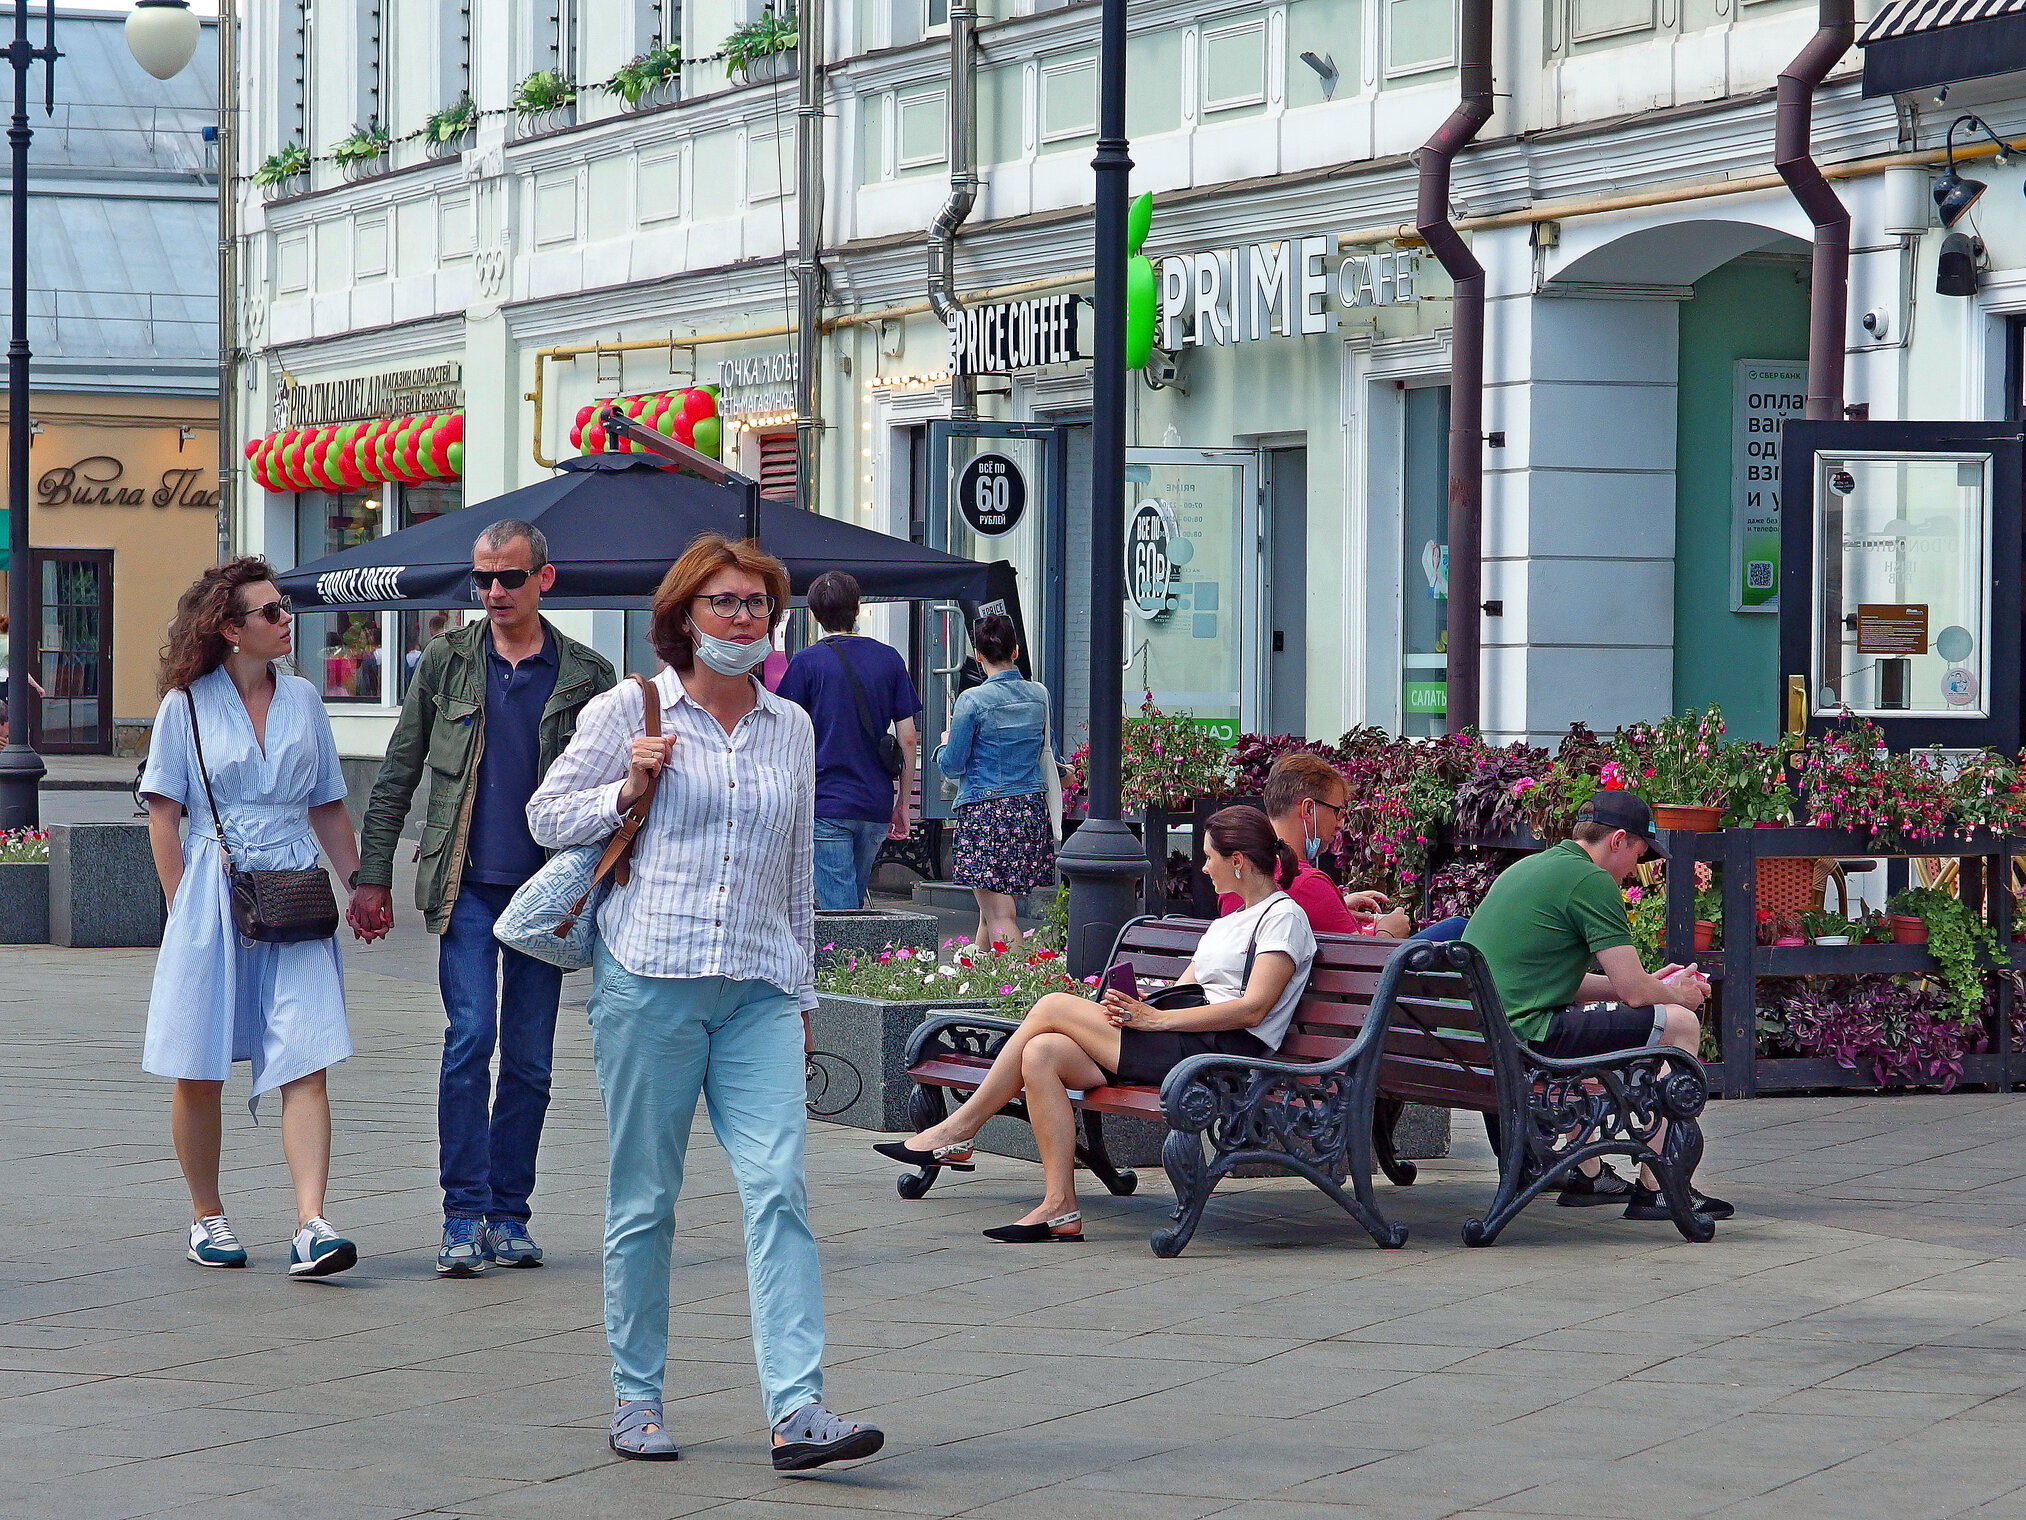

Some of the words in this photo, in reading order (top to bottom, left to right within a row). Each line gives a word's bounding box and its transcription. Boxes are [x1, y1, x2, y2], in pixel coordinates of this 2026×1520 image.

[1338, 250, 1411, 308] CAFE
[1162, 235, 1332, 350] PRIME
[956, 304, 1006, 376] PRICE
[1008, 293, 1070, 368] COFFEE
[381, 370, 412, 389] МАГАЗИН
[717, 357, 759, 388] ТОЧКА
[290, 375, 381, 425] PIRATMARMELAD
[421, 389, 457, 410] ВЗРОСЛЫХ
[718, 396, 739, 416] СЕТЬ
[1748, 393, 1808, 409] опла
[1748, 411, 1788, 433] вай
[1747, 441, 1780, 460] од
[978, 460, 993, 474] ВСЁ
[994, 463, 1006, 474] ПО
[37, 455, 146, 506] Вилла
[975, 475, 1009, 512] 60
[1747, 492, 1761, 506] и
[979, 514, 1006, 525] РУБЛЕЙ
[324, 568, 365, 604] PRICE
[358, 566, 408, 601] COFFEE
